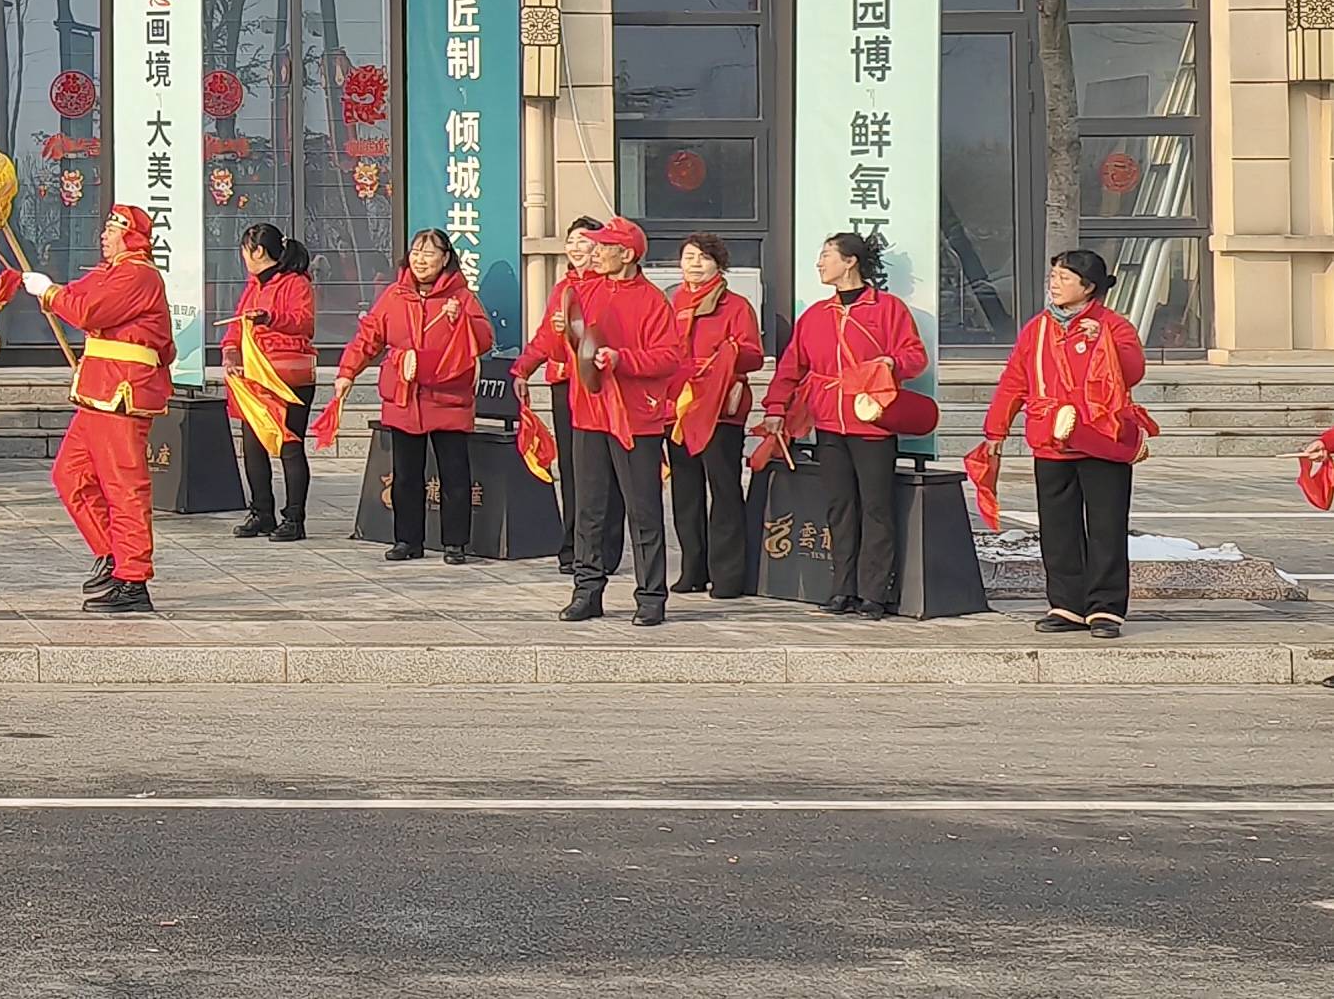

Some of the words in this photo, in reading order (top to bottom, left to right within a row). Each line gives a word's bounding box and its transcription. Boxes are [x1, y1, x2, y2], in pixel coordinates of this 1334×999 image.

[146, 109, 174, 274] 大美云台
[849, 110, 892, 292] 鲜氧环
